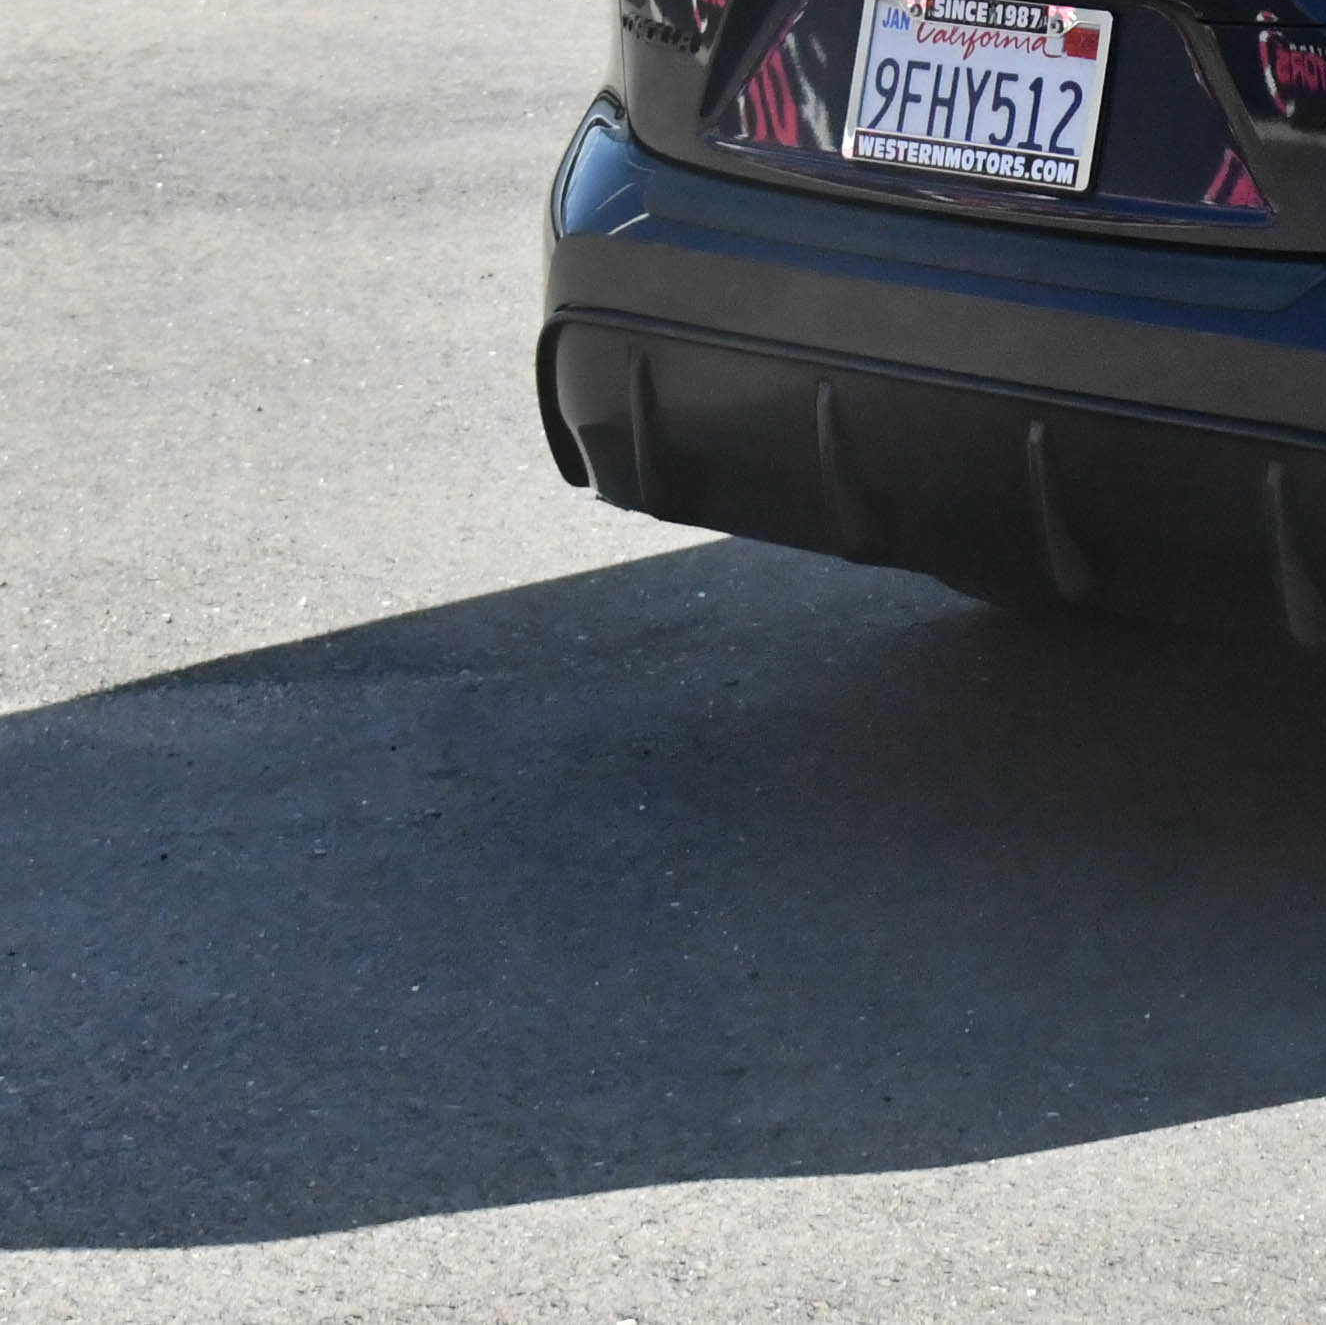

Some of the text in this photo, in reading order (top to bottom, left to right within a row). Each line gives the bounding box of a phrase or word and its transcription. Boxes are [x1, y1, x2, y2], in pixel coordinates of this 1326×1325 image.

[882, 7, 911, 31] JAN
[995, 3, 1042, 29] 1987
[916, 21, 1062, 61] California
[866, 57, 1083, 157] 9FHY512
[858, 135, 1075, 185] WESTERNMOTORS.COM
